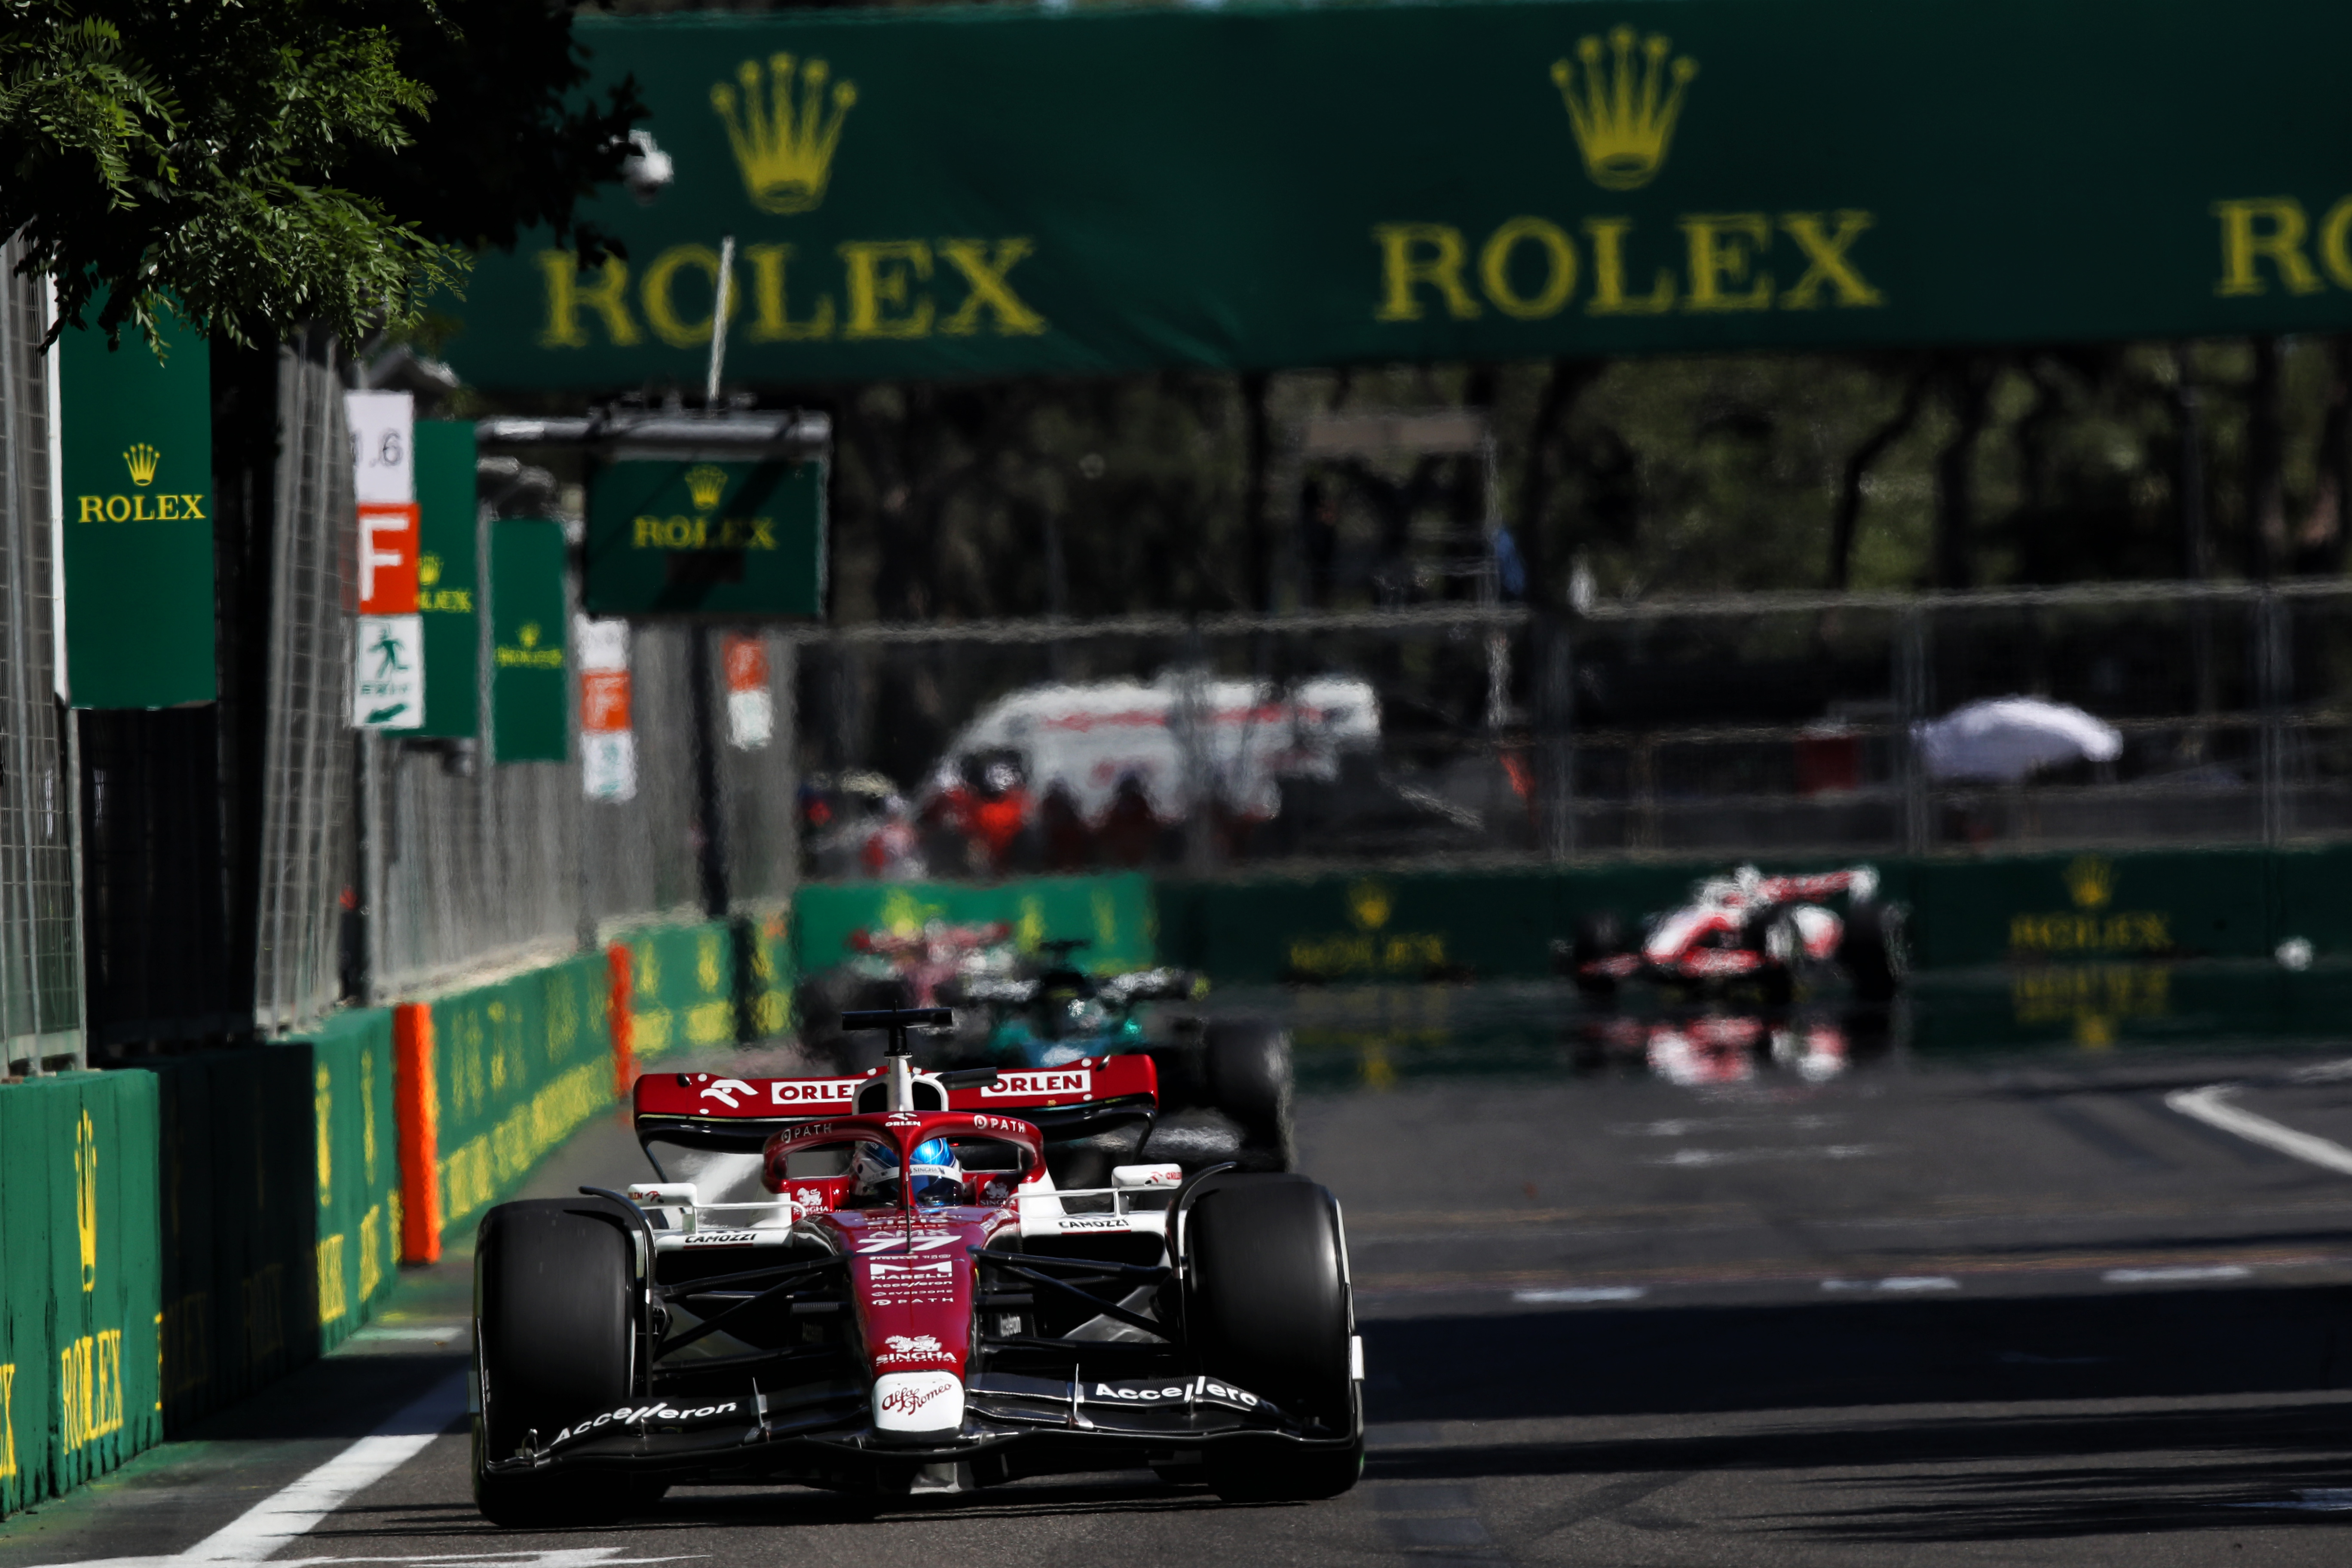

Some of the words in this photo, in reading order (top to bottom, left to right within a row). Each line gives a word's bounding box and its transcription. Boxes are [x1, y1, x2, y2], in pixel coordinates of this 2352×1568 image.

[1370, 209, 1885, 322] ROLEX
[537, 236, 1047, 347] ROLEX
[78, 494, 206, 523] ROLEX
[634, 517, 775, 550] ROLEX
[358, 516, 410, 601] F
[778, 1084, 862, 1100] ORLE
[988, 1075, 1082, 1093] ORLEN
[795, 1123, 833, 1139] PATH
[990, 1118, 1026, 1133] PATH
[1059, 1219, 1130, 1228] CAMOZZI
[685, 1233, 758, 1243] CAMOZZI
[856, 1236, 962, 1253] 77
[876, 1352, 957, 1364] SINGHA
[61, 1329, 123, 1455] ROLEX
[882, 1387, 919, 1413] Alfa
[902, 1383, 952, 1416] Romeo
[550, 1402, 737, 1447] Accelleron
